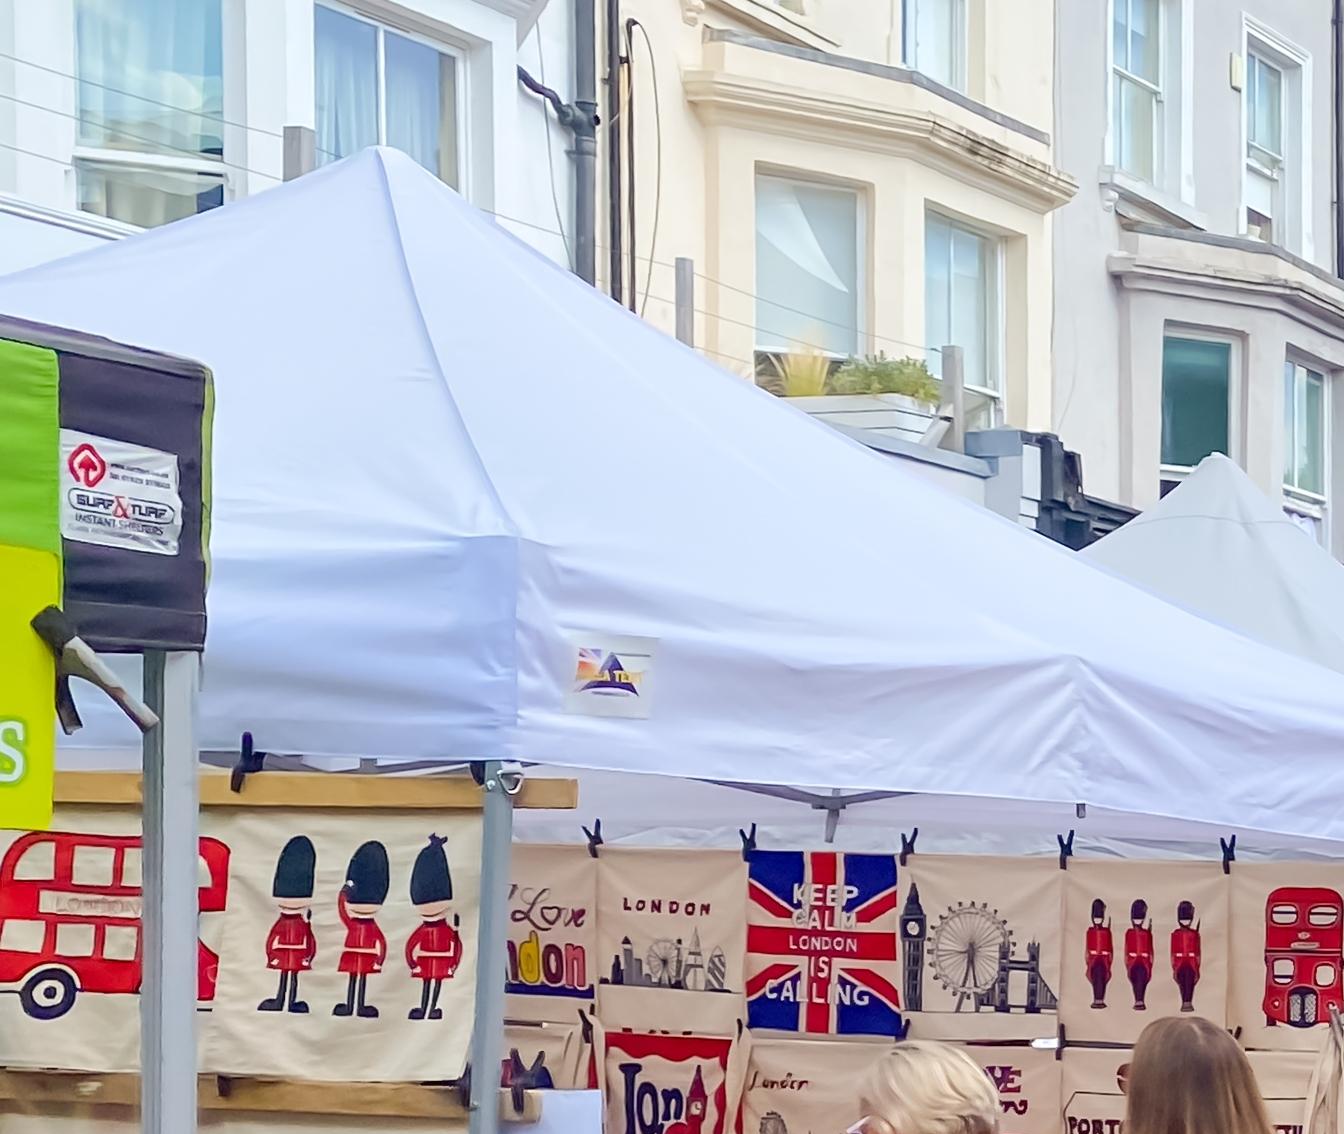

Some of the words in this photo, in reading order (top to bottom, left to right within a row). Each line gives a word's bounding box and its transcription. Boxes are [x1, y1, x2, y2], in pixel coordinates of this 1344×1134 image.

[792, 883, 860, 907] KEEP
[623, 897, 711, 917] LONDON
[791, 909, 857, 931] CALM
[789, 935, 857, 952] LONDON
[810, 956, 830, 979] IS
[765, 979, 870, 1006] CALLING
